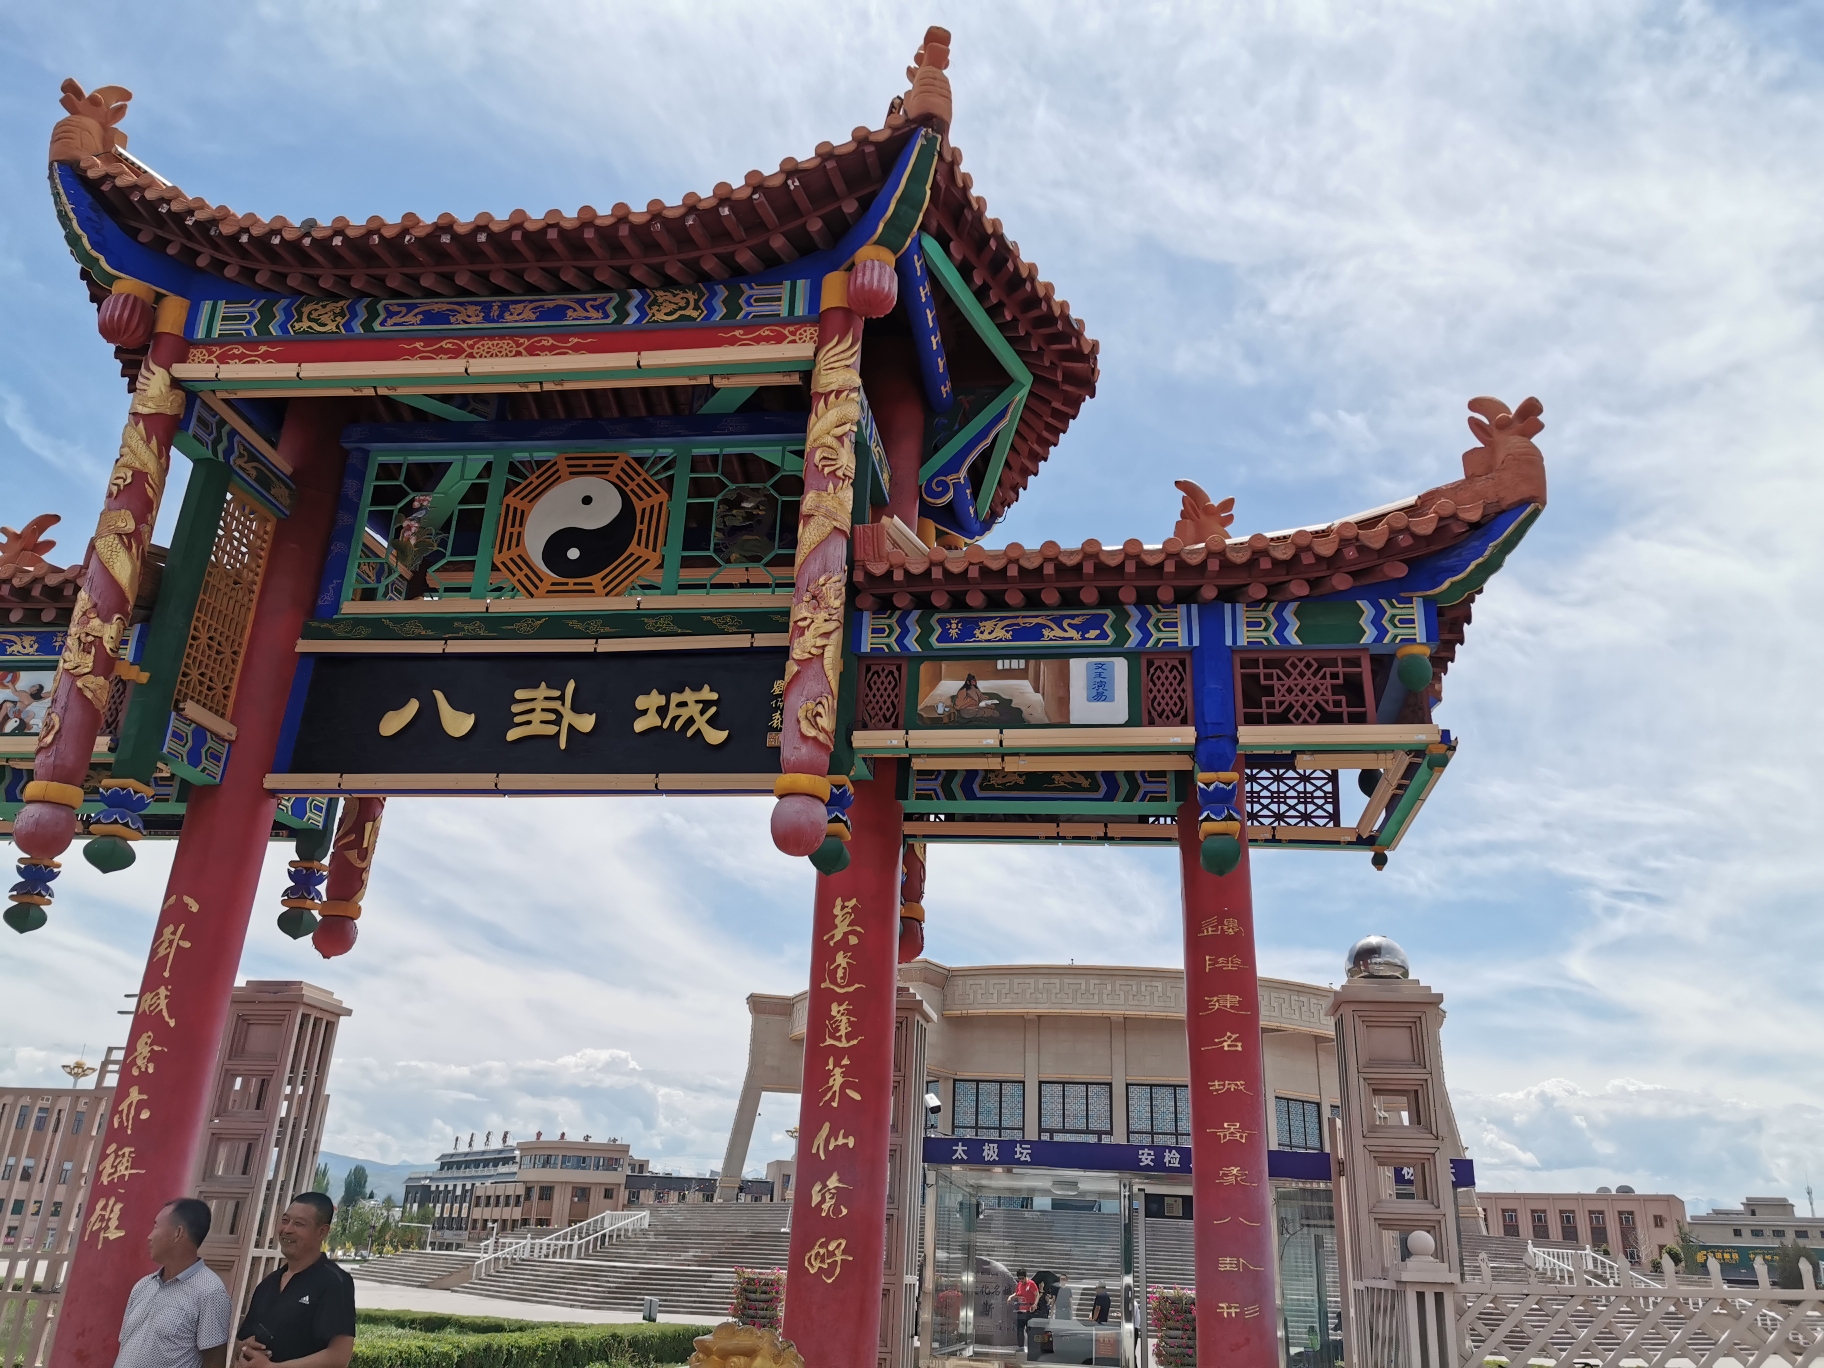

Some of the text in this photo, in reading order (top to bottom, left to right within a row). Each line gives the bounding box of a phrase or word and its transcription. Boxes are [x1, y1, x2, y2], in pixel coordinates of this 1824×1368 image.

[1092, 662, 1108, 702] 文王演易
[378, 678, 729, 750] 八卦城
[952, 1142, 1194, 1168] 太极坛 安检
